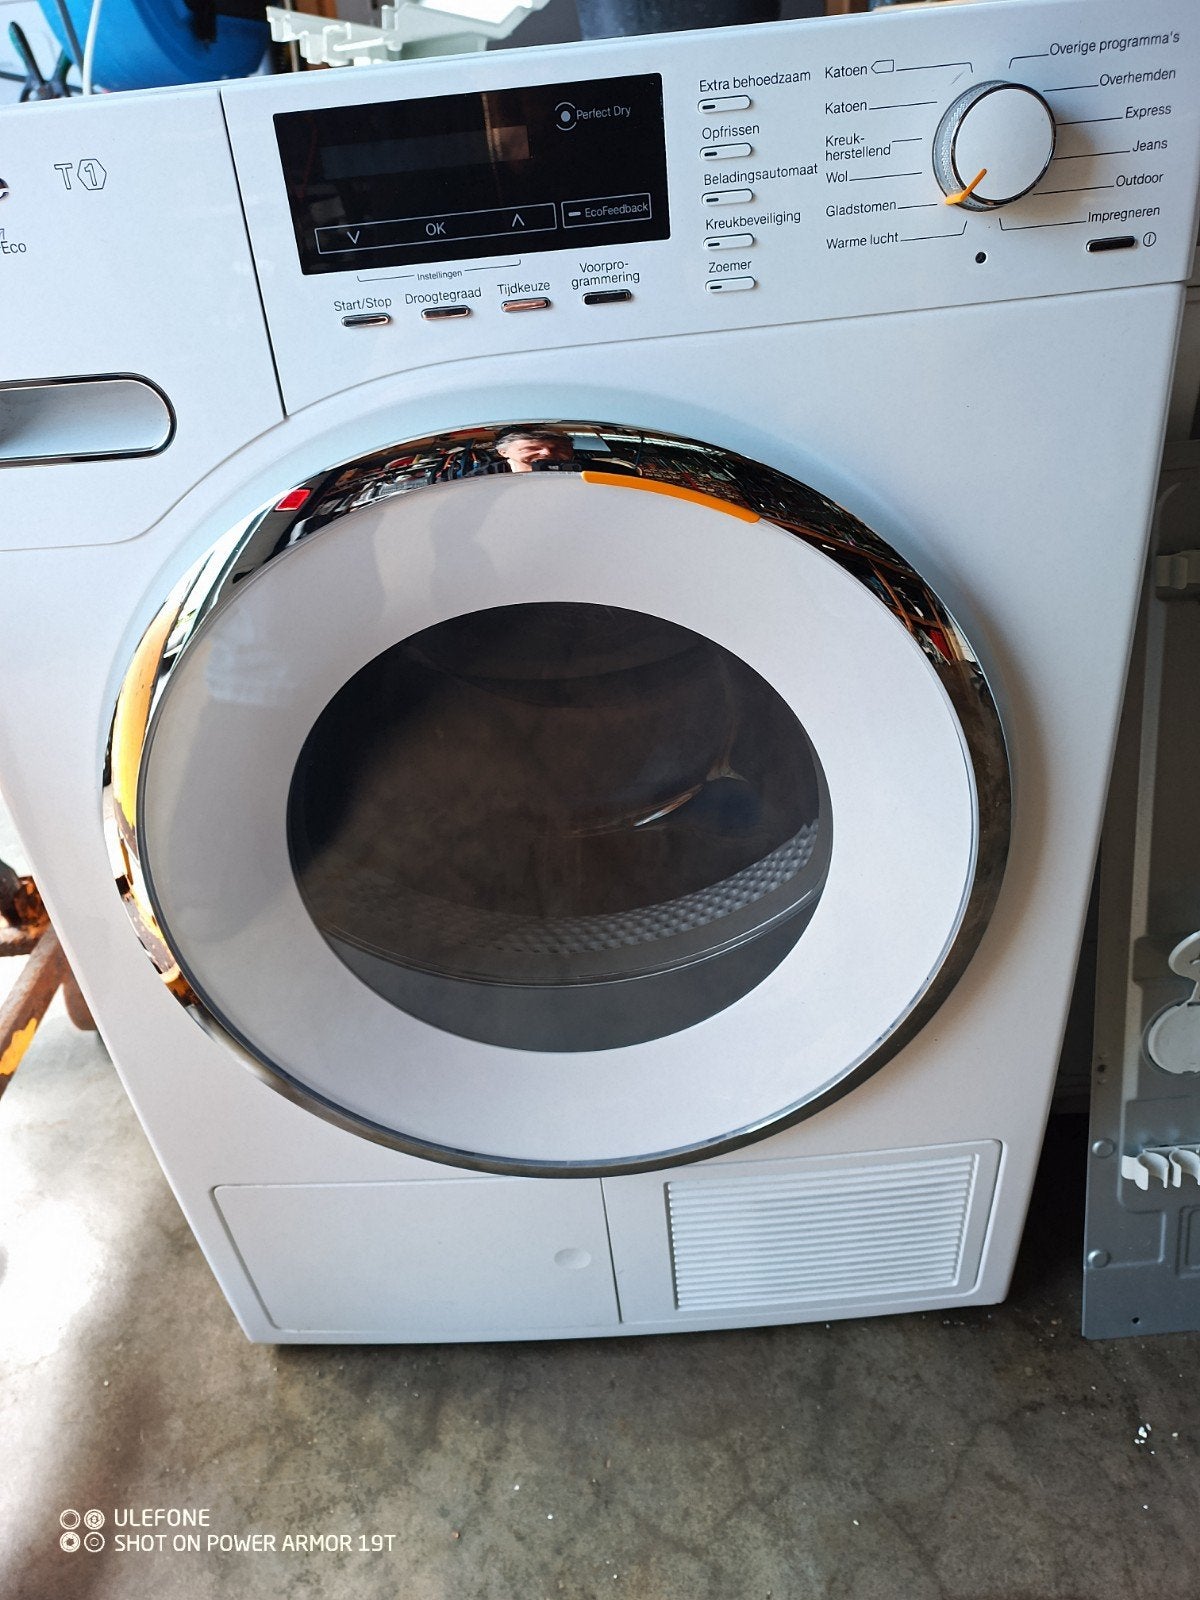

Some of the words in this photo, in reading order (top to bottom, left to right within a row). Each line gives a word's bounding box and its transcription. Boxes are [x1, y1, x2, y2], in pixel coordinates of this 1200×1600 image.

[1050, 41, 1095, 55] Overige
[1099, 31, 1180, 53] programma's
[825, 64, 868, 79] Katoen
[1100, 68, 1176, 87] Overhemden
[699, 78, 730, 92] Extra
[733, 70, 811, 89] behoedzaam
[576, 107, 611, 120] Perfect
[613, 105, 631, 117] Dry
[825, 100, 867, 115] Katoen
[1125, 103, 1172, 120] Express
[701, 123, 760, 141] Opfrissen
[825, 133, 865, 147] Kreuk-
[825, 144, 891, 161] herstellend
[1132, 139, 1168, 152] Jeans
[704, 163, 818, 184] Beladingsautomaat
[826, 171, 848, 184] Wol
[1115, 172, 1164, 187] Outdoor
[584, 202, 649, 218] EcoFeedback
[825, 200, 897, 218] Gladstomen
[1087, 206, 1161, 224] Impregneren
[425, 221, 447, 236] OK
[705, 211, 801, 230] Kreukbeveiliging
[0, 241, 27, 254] Eco
[826, 236, 867, 250] Warme
[869, 231, 899, 245] lucht
[416, 270, 463, 281] Instellingen
[579, 260, 629, 275] Voorpro-
[708, 261, 752, 274] Zoemer
[571, 271, 641, 289] grammering
[405, 287, 482, 304] Droogtegraad
[498, 281, 550, 296] Tijdkeuze
[333, 297, 392, 313] Start/Stop
